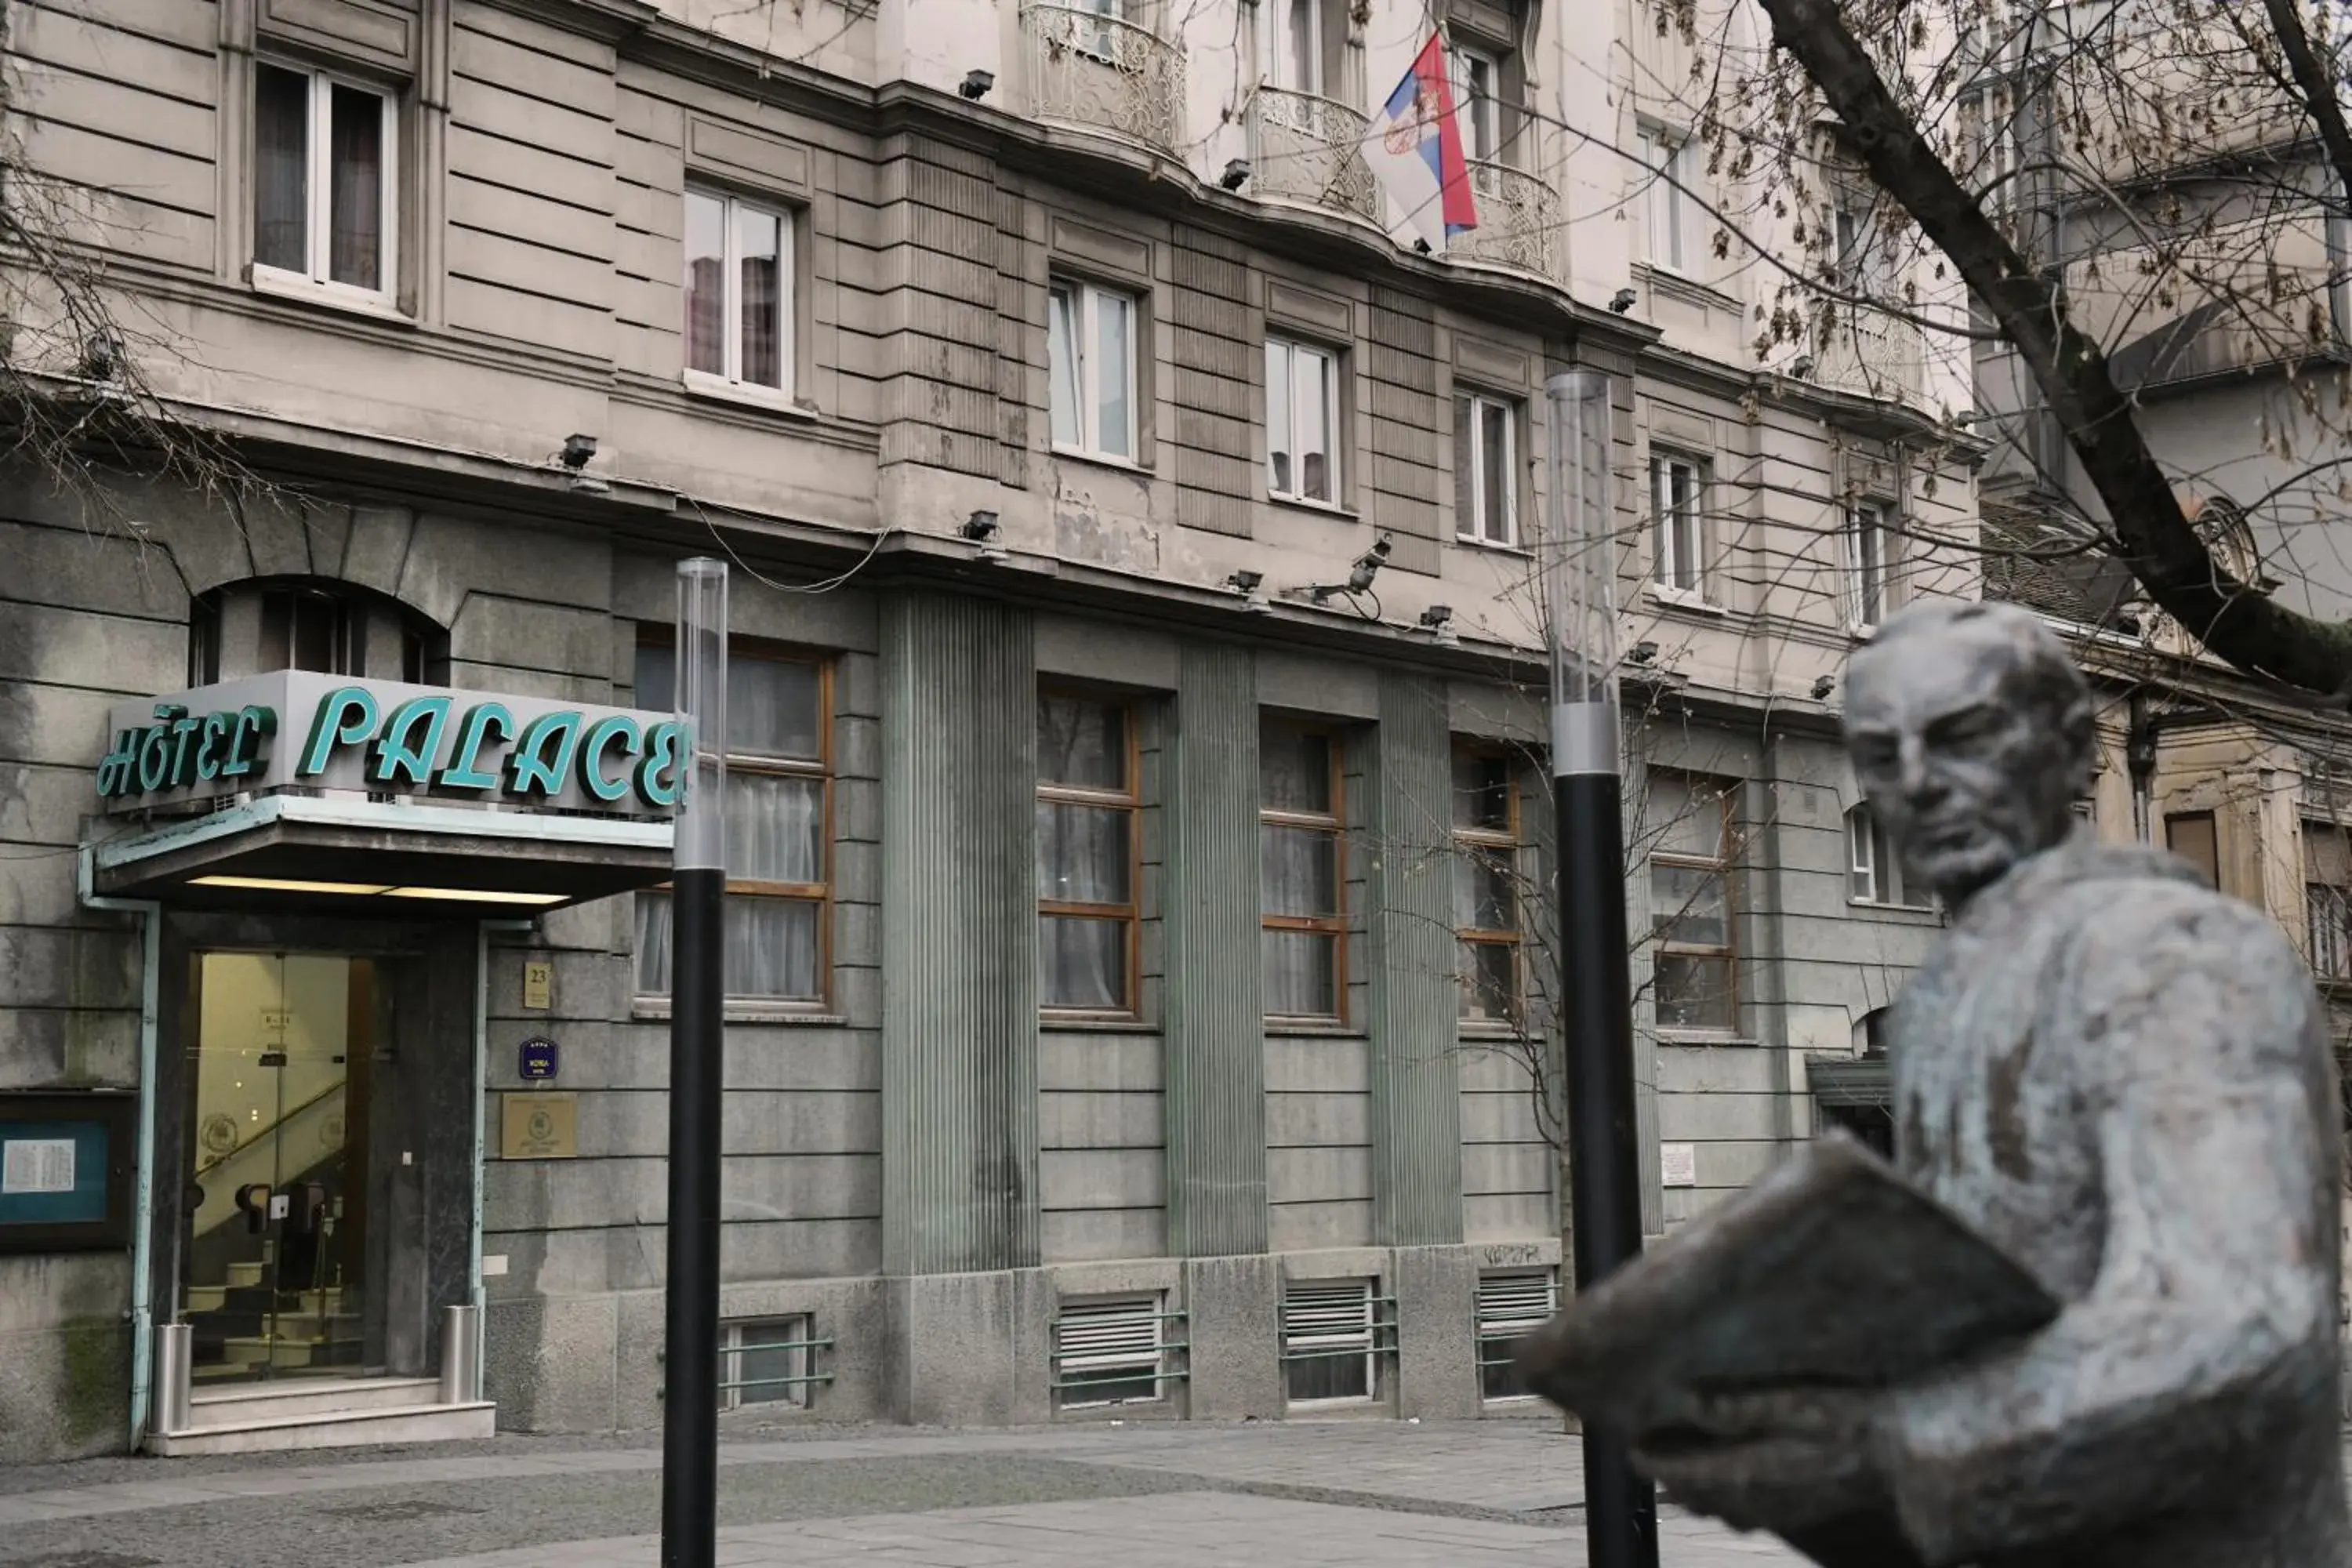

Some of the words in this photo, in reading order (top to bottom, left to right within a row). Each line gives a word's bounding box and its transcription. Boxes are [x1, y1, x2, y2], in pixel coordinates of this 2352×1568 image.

[2069, 257, 2137, 285] HTEL
[296, 686, 693, 808] PALACE
[530, 968, 546, 985] 23
